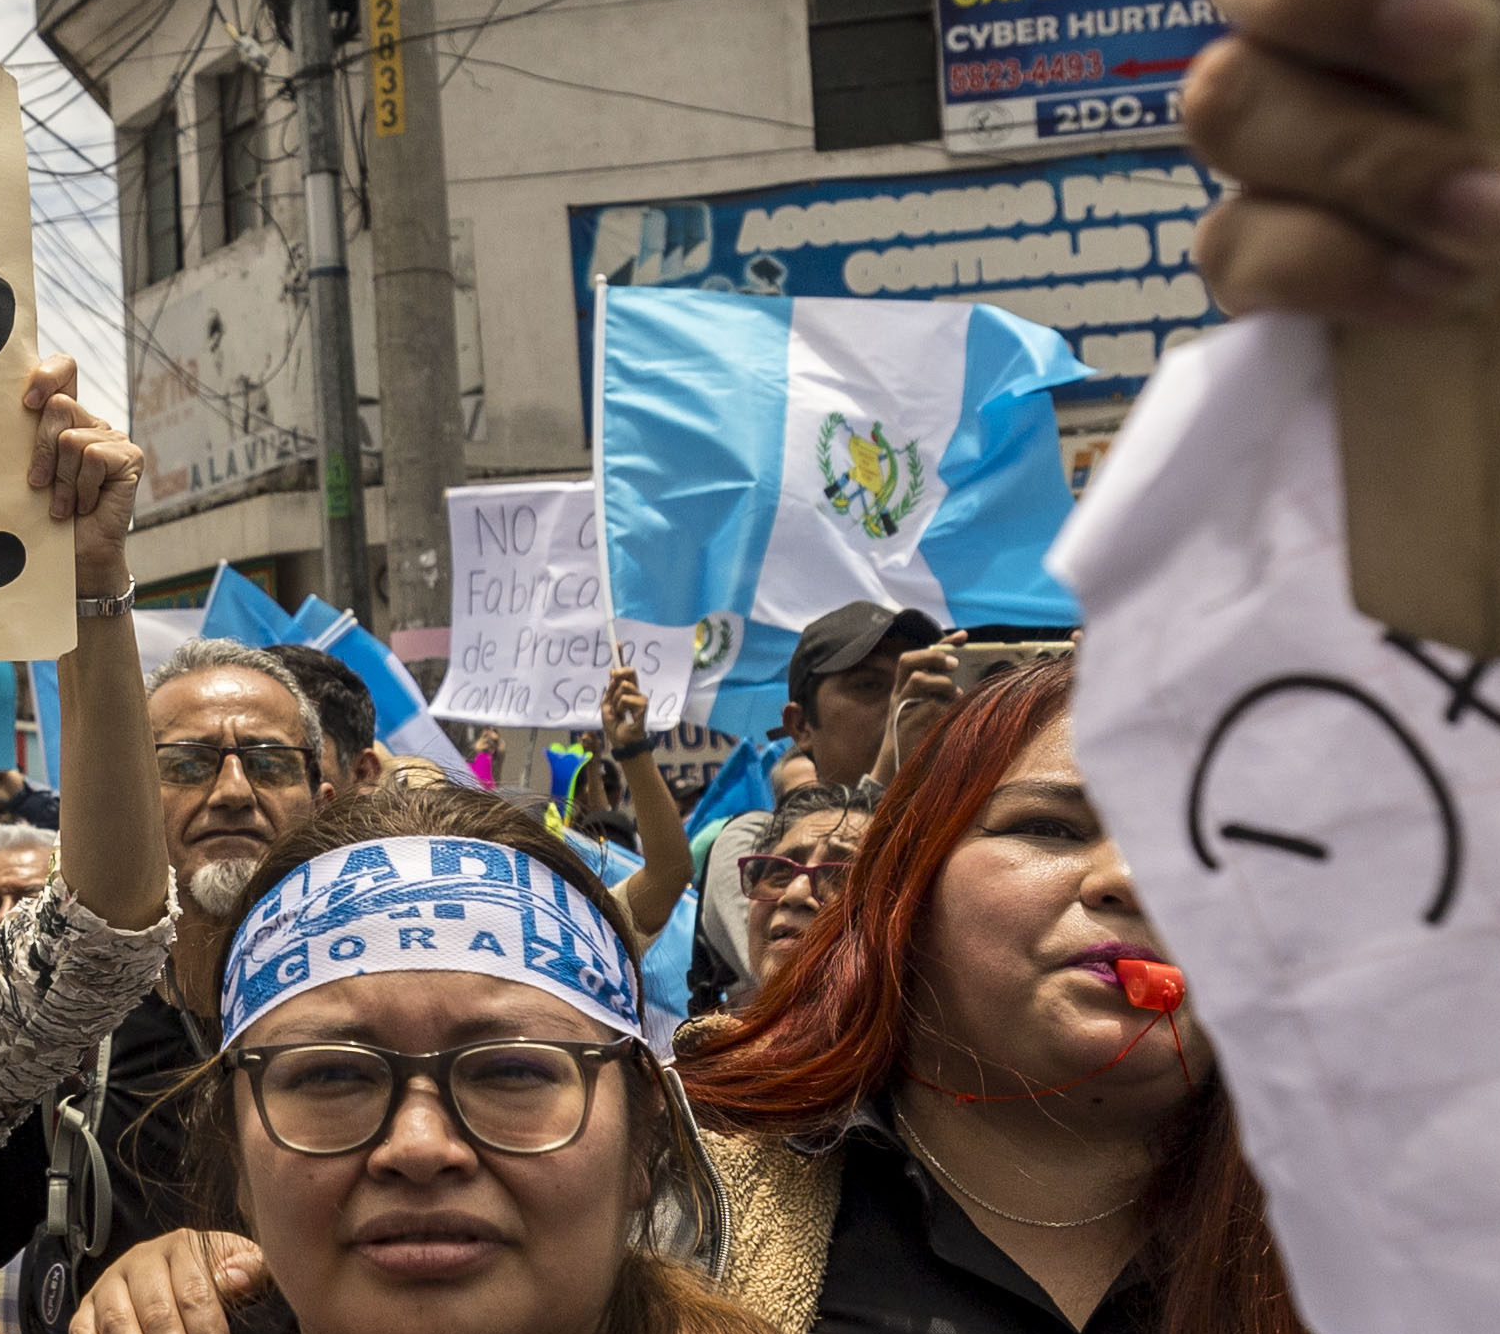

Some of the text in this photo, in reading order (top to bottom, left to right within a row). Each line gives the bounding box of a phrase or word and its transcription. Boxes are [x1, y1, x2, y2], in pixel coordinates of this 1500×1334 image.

[945, 16, 1059, 52] CYBER
[949, 49, 1104, 94] 5823-4493
[1054, 95, 1156, 133] 2DO.
[475, 505, 537, 557] NO
[467, 569, 601, 616] Fabrica
[462, 633, 497, 673] de
